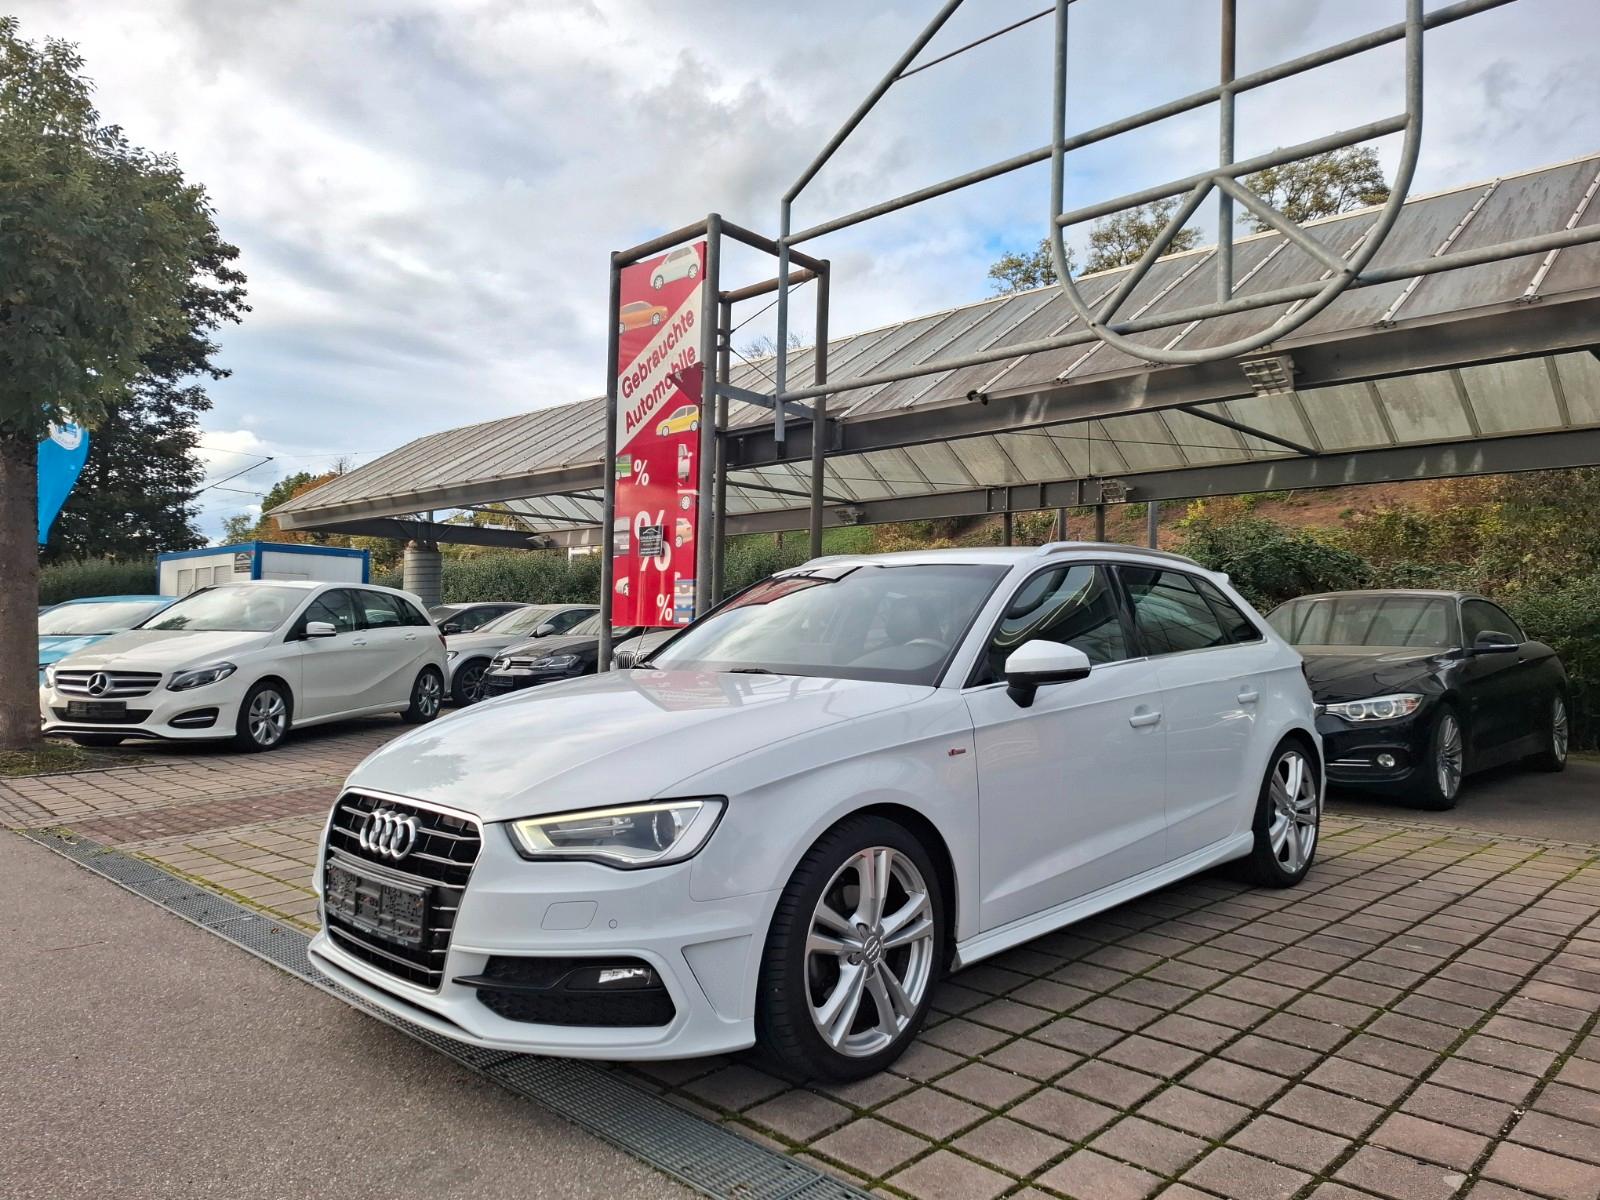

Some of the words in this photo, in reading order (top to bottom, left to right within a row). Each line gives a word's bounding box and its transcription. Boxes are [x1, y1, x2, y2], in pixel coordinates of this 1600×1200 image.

[622, 310, 694, 398] Gebrauchte
[634, 460, 649, 486] %
[657, 594, 672, 620] %
